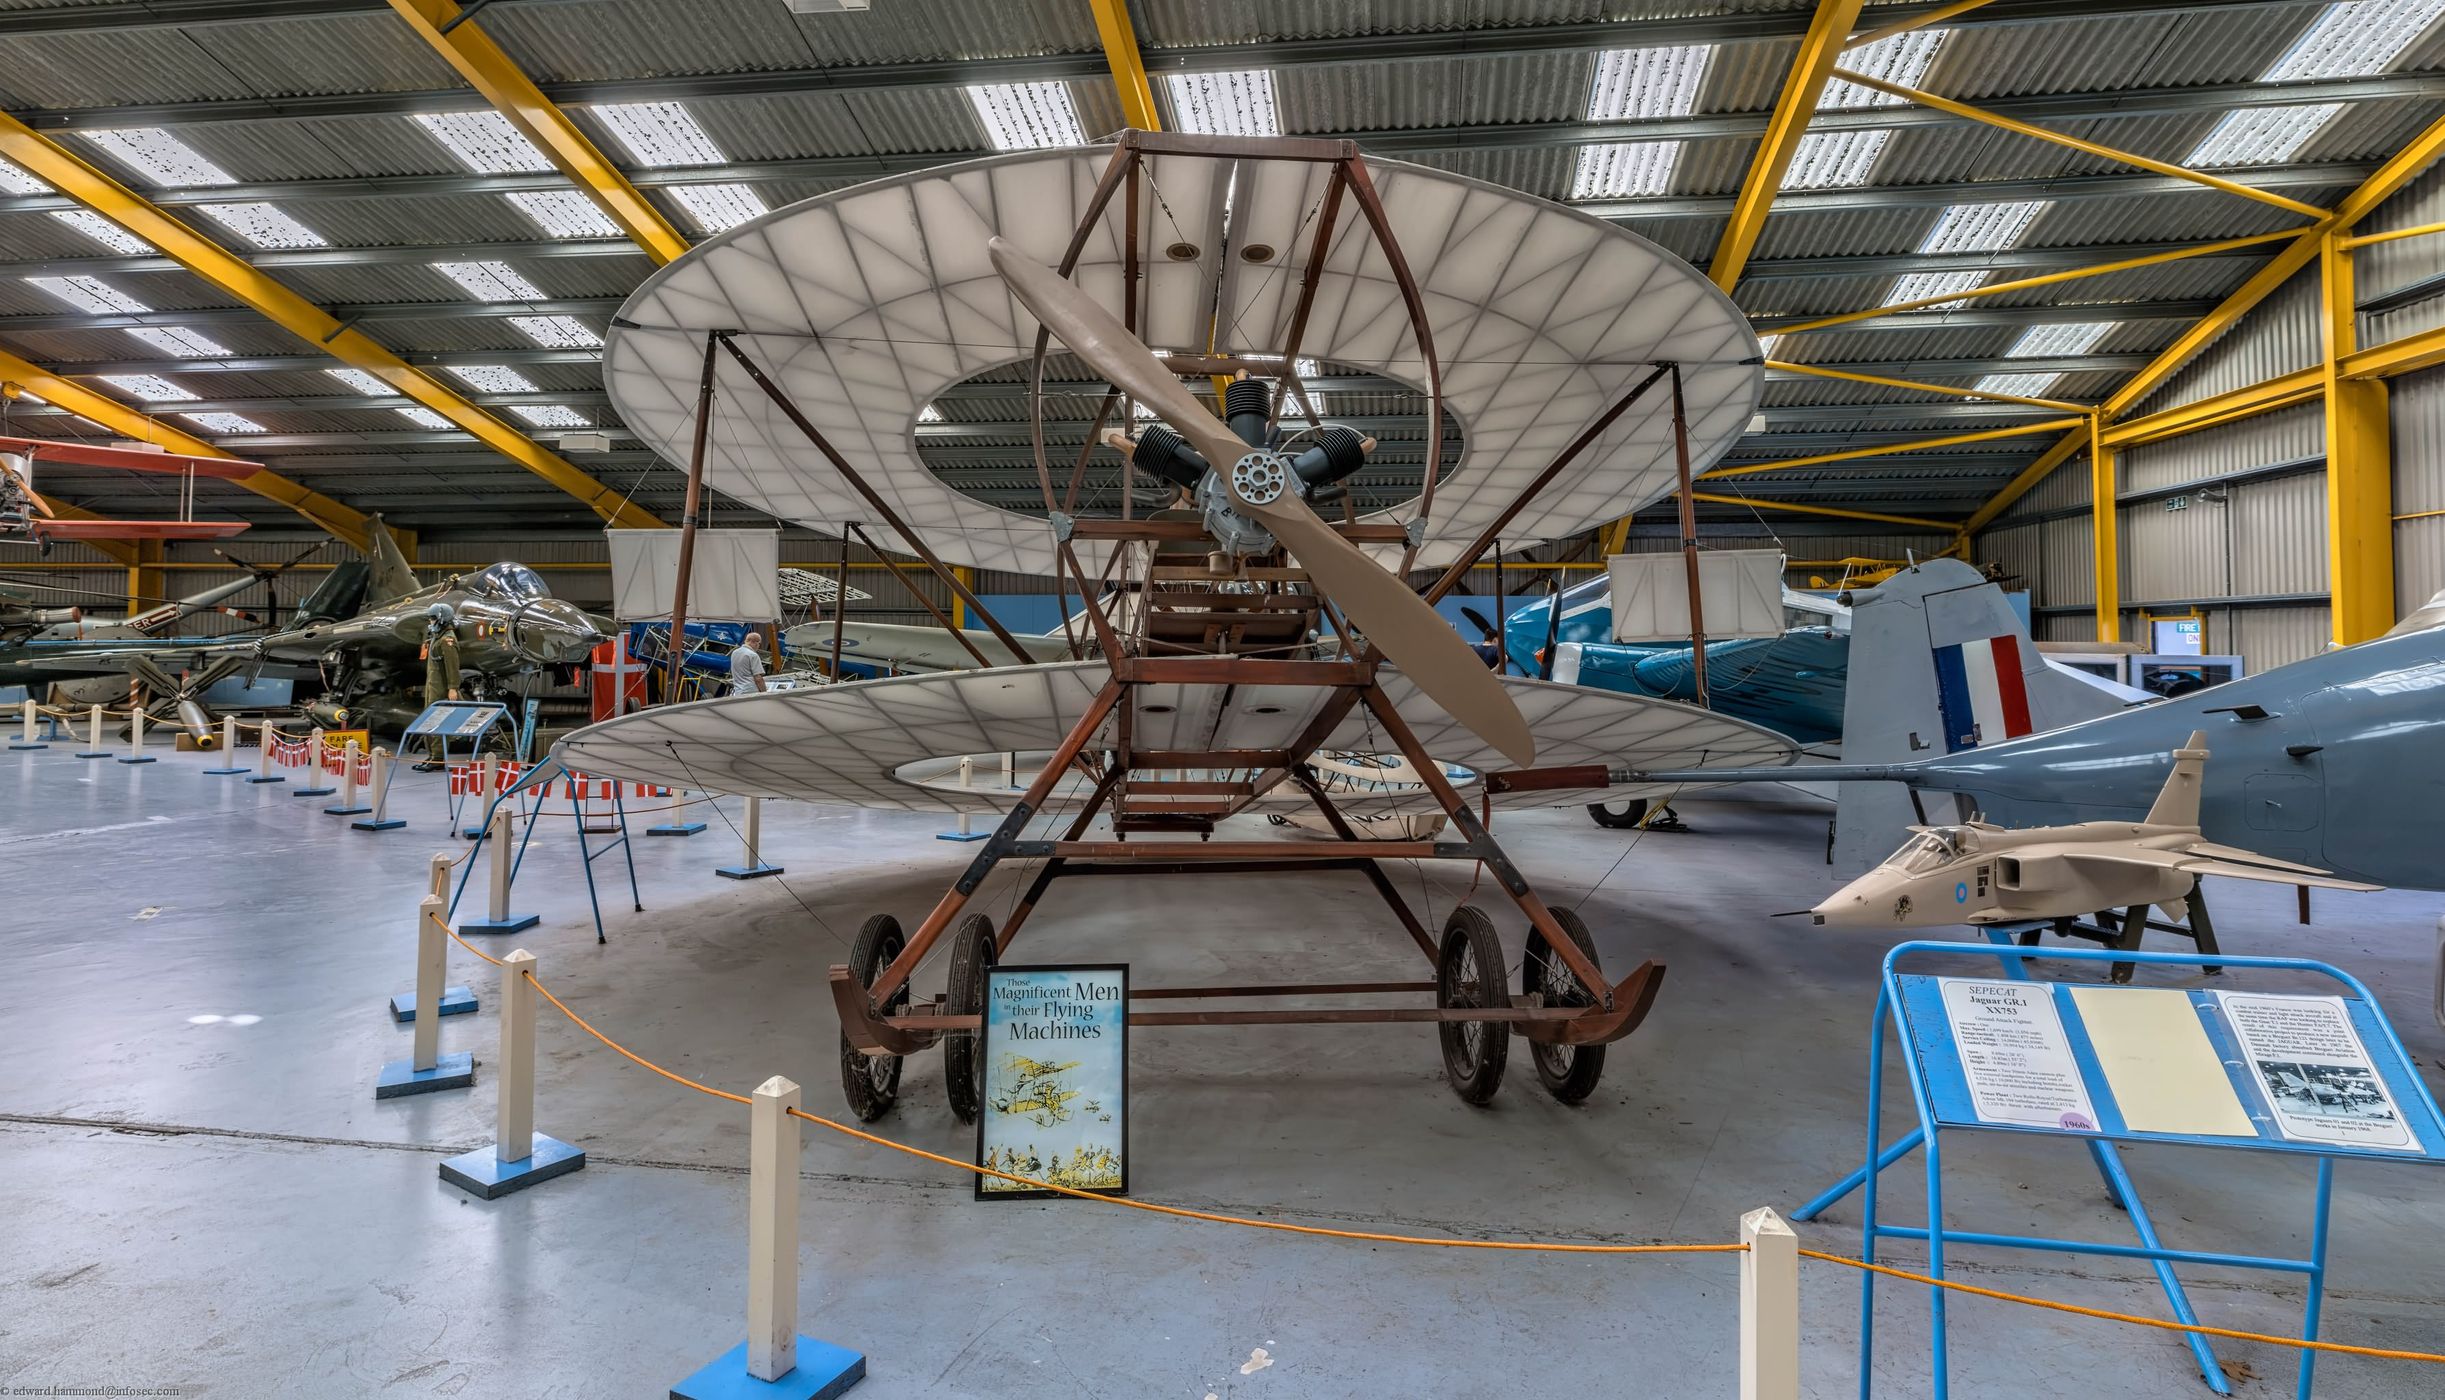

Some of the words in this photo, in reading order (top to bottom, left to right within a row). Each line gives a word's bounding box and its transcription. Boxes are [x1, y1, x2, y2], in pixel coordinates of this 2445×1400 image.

[2179, 623, 2196, 632] FIRE
[993, 986, 1071, 1001] Magnificent
[1075, 983, 1119, 1000] Men
[1968, 986, 2018, 996] SEPECAT
[1969, 996, 2002, 1004] Jaguar
[1012, 1004, 1039, 1016] their
[1044, 1001, 1094, 1021] Flying
[1986, 1006, 2018, 1015] XX753
[1010, 1021, 1101, 1040] Machines
[2064, 1120, 2090, 1129] 1960s
